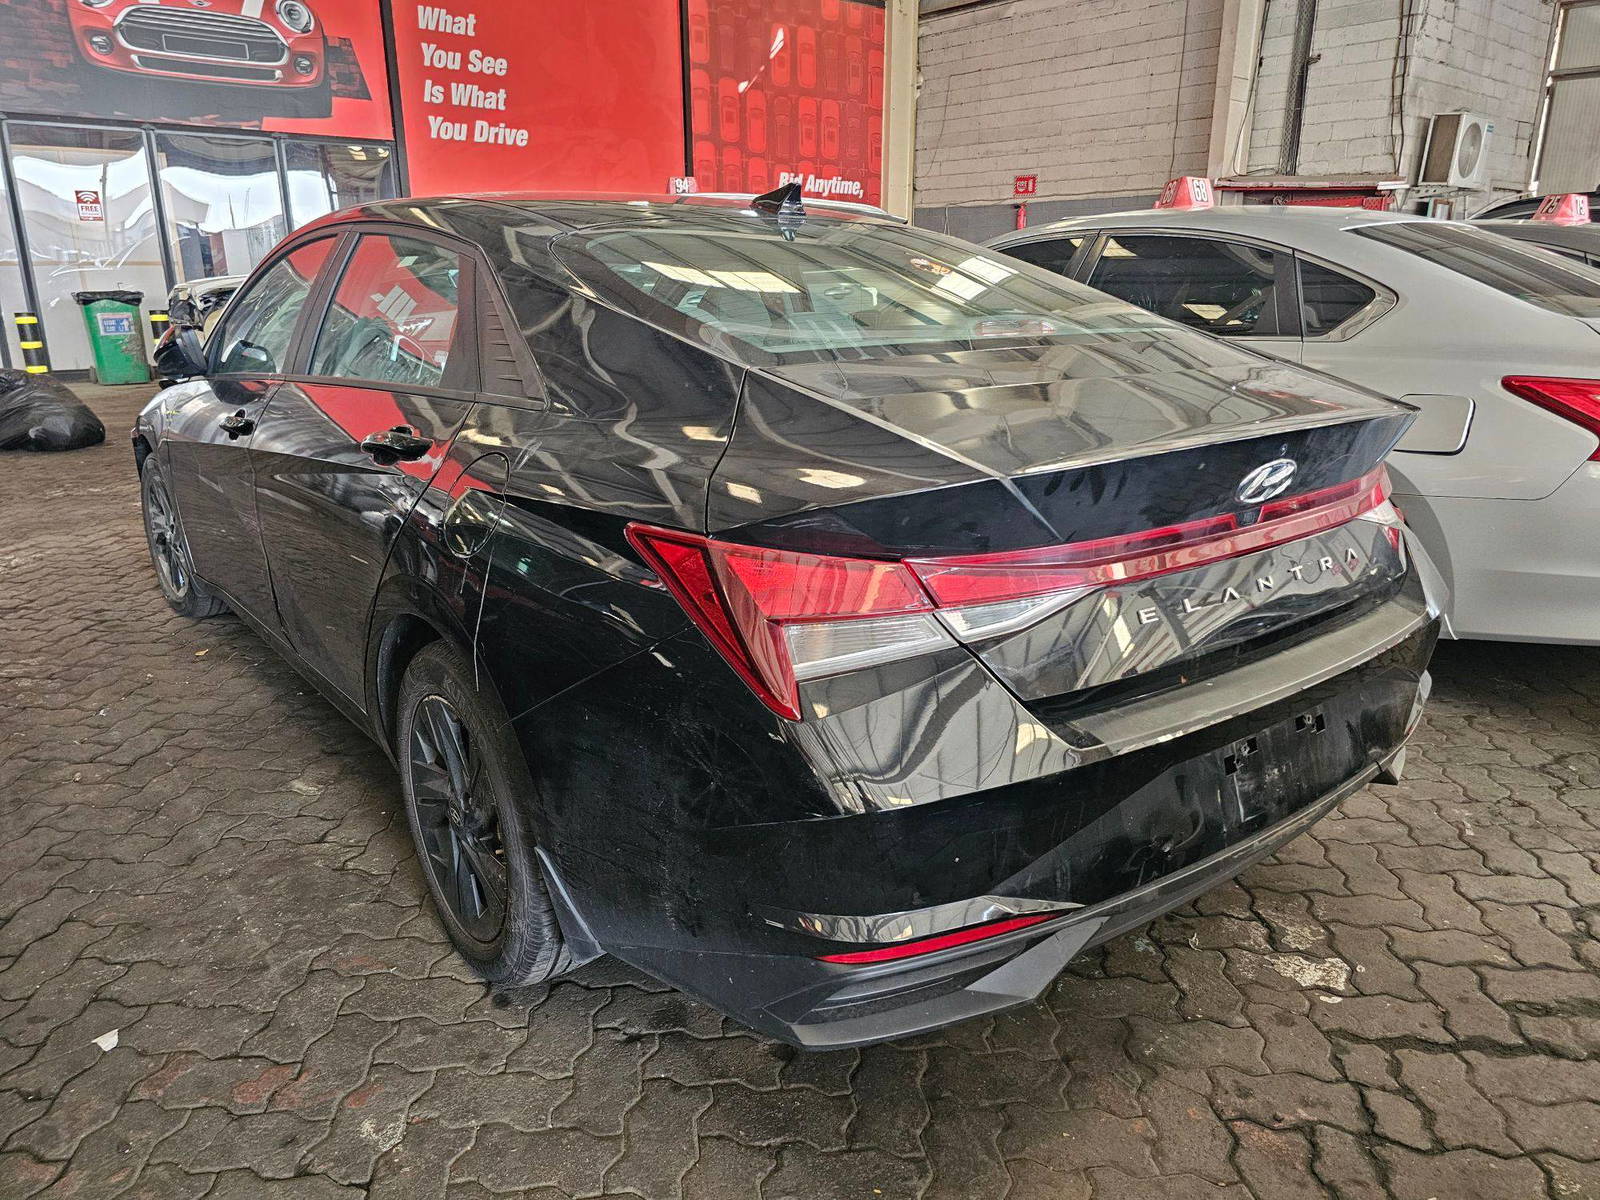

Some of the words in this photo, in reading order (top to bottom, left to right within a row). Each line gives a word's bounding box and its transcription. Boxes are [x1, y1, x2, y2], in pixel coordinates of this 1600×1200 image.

[417, 5, 476, 36] What
[421, 42, 462, 70] You
[467, 49, 508, 76] See
[423, 79, 445, 104] Is
[450, 82, 507, 111] What
[428, 115, 468, 141] You
[474, 120, 529, 147] Drive
[675, 177, 690, 194] 94
[804, 174, 864, 199] Anytime,
[1192, 179, 1208, 202] 68
[1541, 195, 1561, 214] 75
[1137, 547, 1357, 625] ELANTRA
